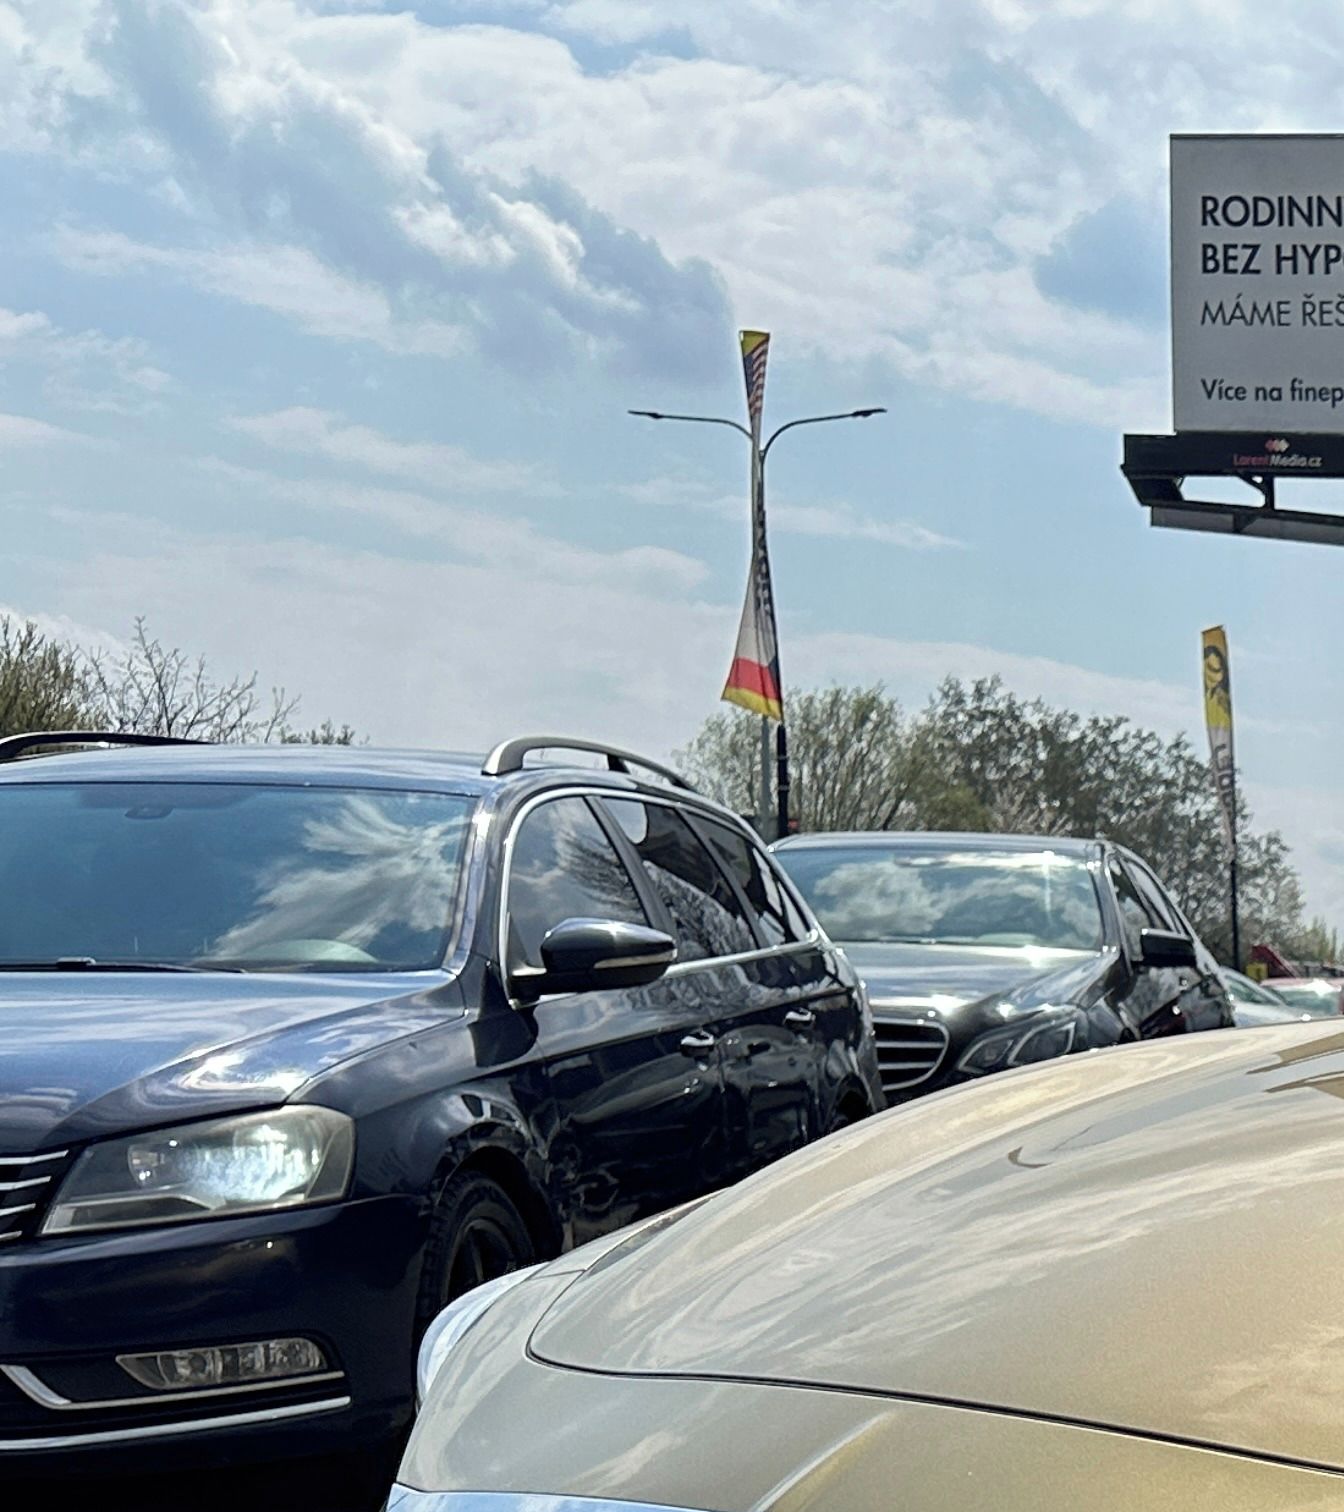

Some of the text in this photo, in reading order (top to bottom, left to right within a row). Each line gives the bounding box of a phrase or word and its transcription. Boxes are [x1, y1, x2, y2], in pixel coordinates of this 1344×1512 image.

[1201, 243, 1262, 275] BEZ
[1200, 293, 1292, 327] MÁME
[1200, 378, 1248, 401] Více
[1255, 387, 1283, 402] na
